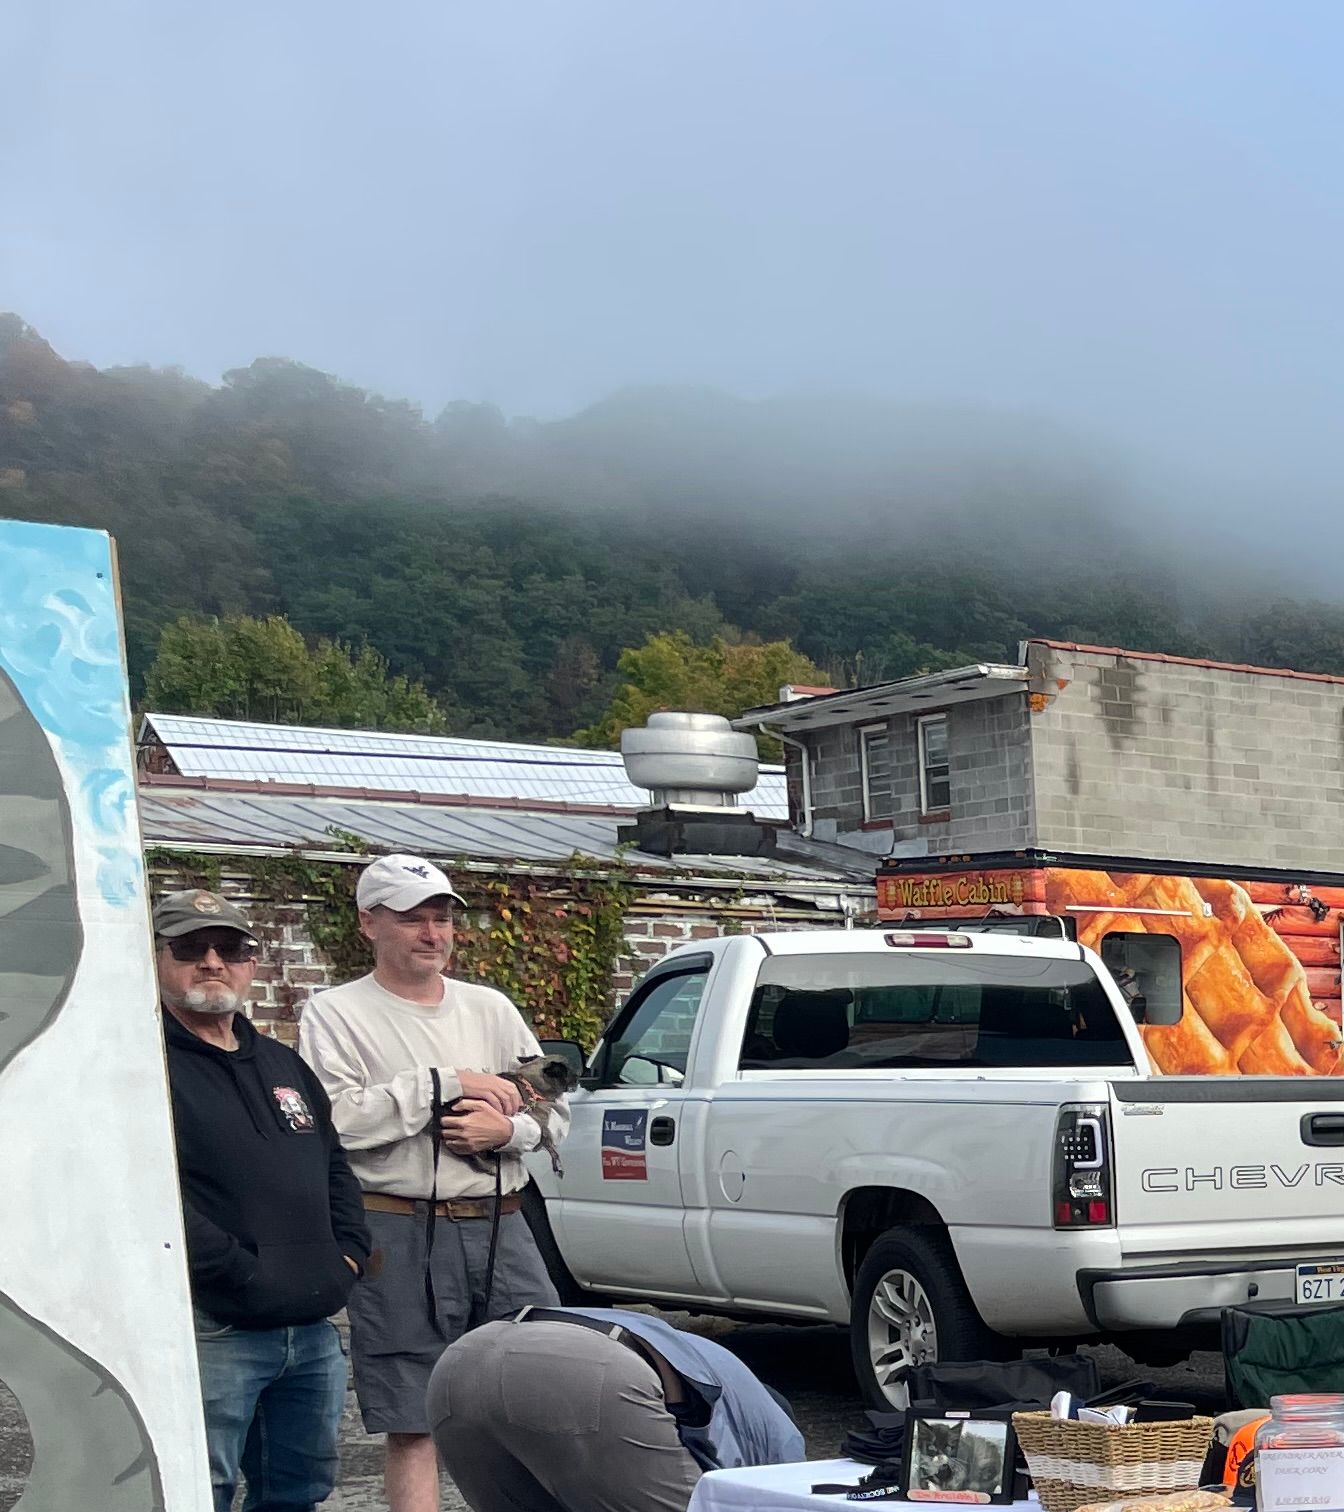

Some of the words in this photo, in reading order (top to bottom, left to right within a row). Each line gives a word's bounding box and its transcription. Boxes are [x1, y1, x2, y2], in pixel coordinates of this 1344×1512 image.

[898, 878, 952, 906] Waffle
[956, 877, 1008, 904] Cabin
[1302, 1279, 1334, 1299] 6ZT
